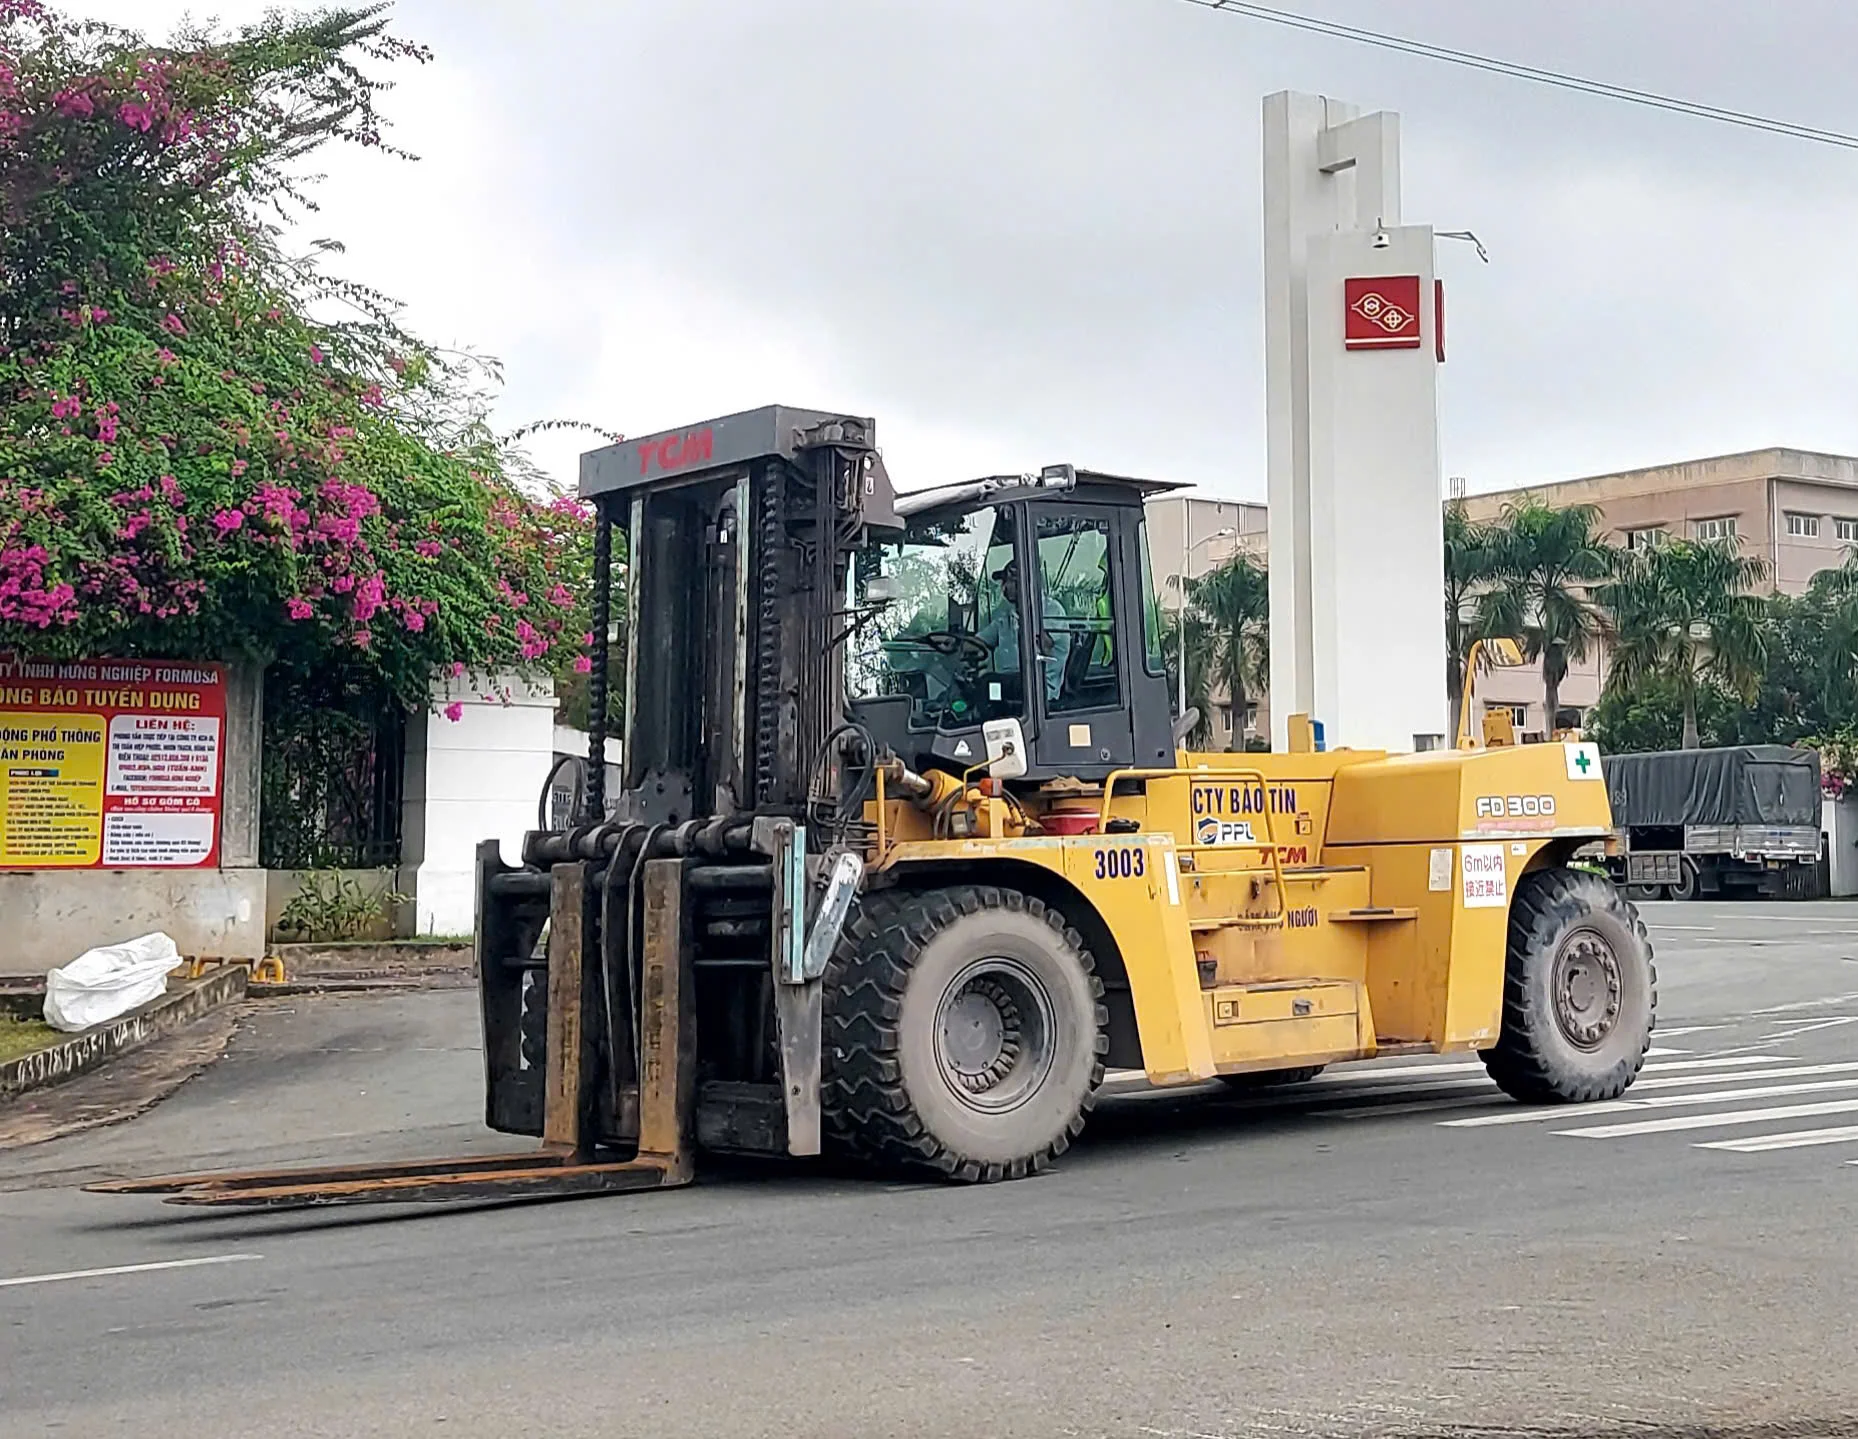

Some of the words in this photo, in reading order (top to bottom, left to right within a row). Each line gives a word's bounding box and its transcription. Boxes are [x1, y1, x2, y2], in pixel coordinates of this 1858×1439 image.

[637, 427, 713, 475] TCM
[101, 664, 151, 684] NGHIỆP
[155, 668, 218, 685] FORMOSA
[40, 685, 78, 705] BÁO
[84, 684, 144, 706] TUYỂN
[150, 692, 200, 712] DỤNG
[61, 728, 101, 743] THÔNG
[22, 747, 65, 761] PHÒNG
[1193, 788, 1223, 814] CTY
[1222, 823, 1254, 840] PPL
[1095, 848, 1144, 879] 3003
